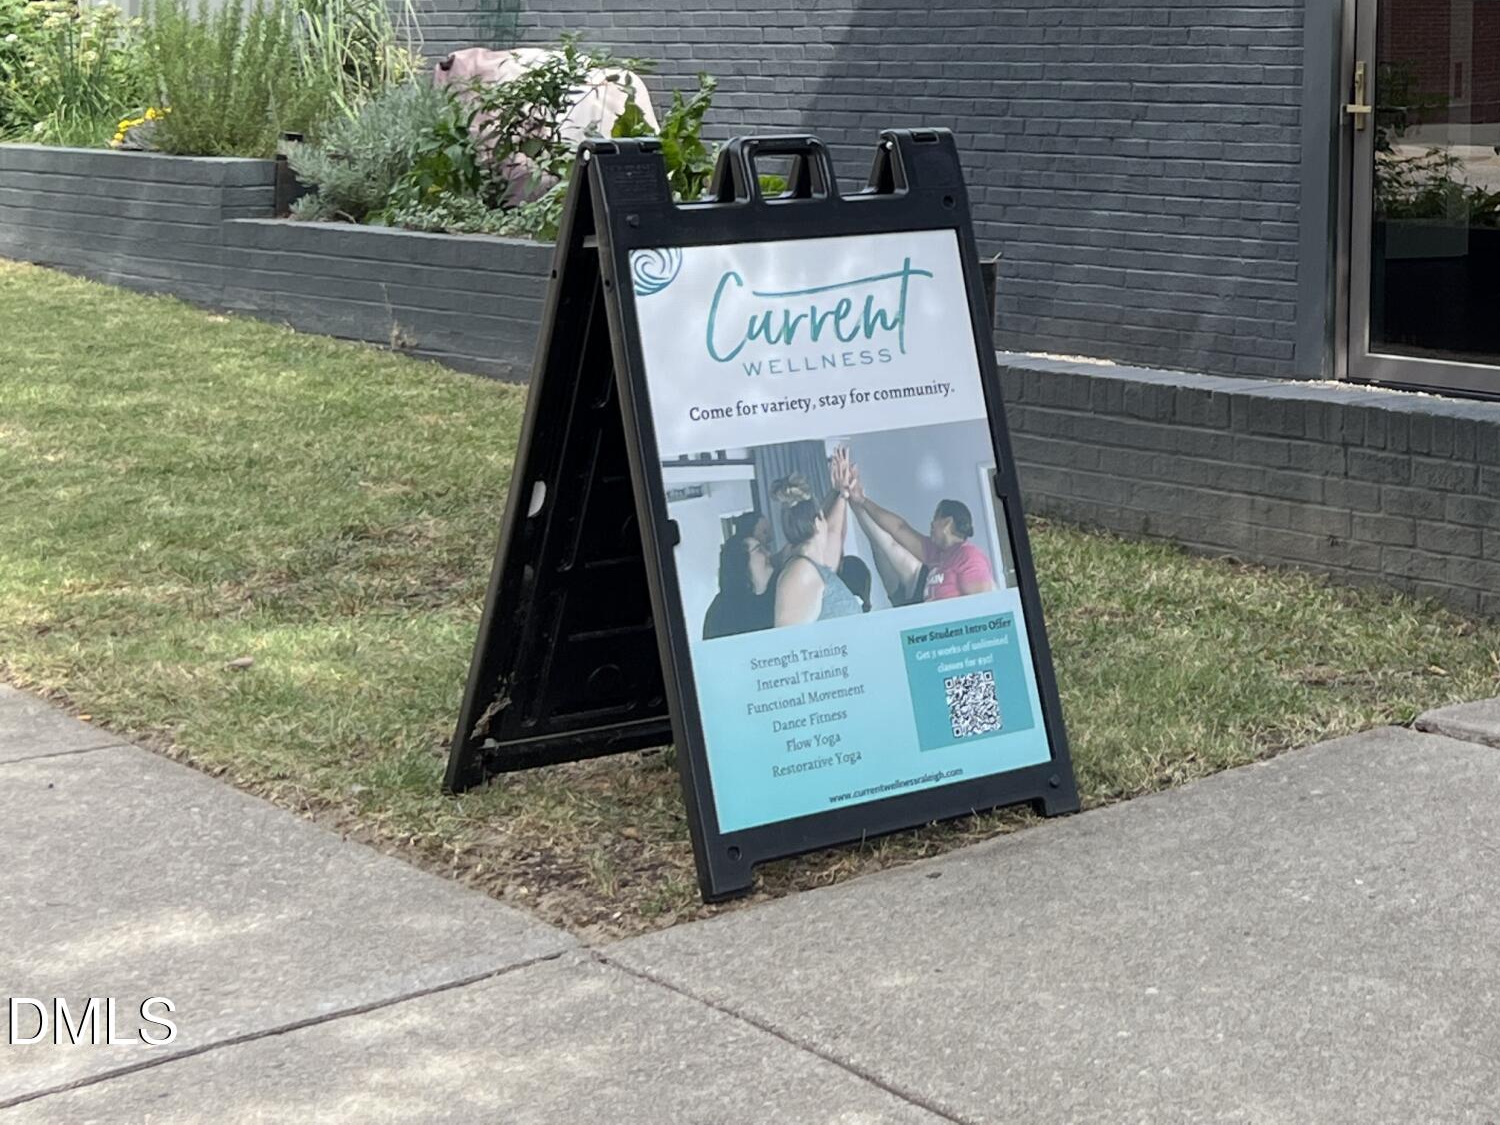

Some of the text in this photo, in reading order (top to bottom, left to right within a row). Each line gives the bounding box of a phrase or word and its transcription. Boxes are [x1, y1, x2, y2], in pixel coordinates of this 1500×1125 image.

[706, 256, 933, 362] Current
[743, 348, 893, 376] WELLNESS
[689, 380, 955, 421] Come for variety, stay for community.
[907, 617, 1012, 645] New Student Intro Offer
[750, 644, 848, 670] Strength Training
[757, 666, 849, 691] Interval Training
[747, 684, 865, 715] Functional Movement
[772, 710, 847, 733] Dance Fitness
[786, 733, 841, 752] Flow Yoga
[772, 751, 862, 777] Restorative Yoga
